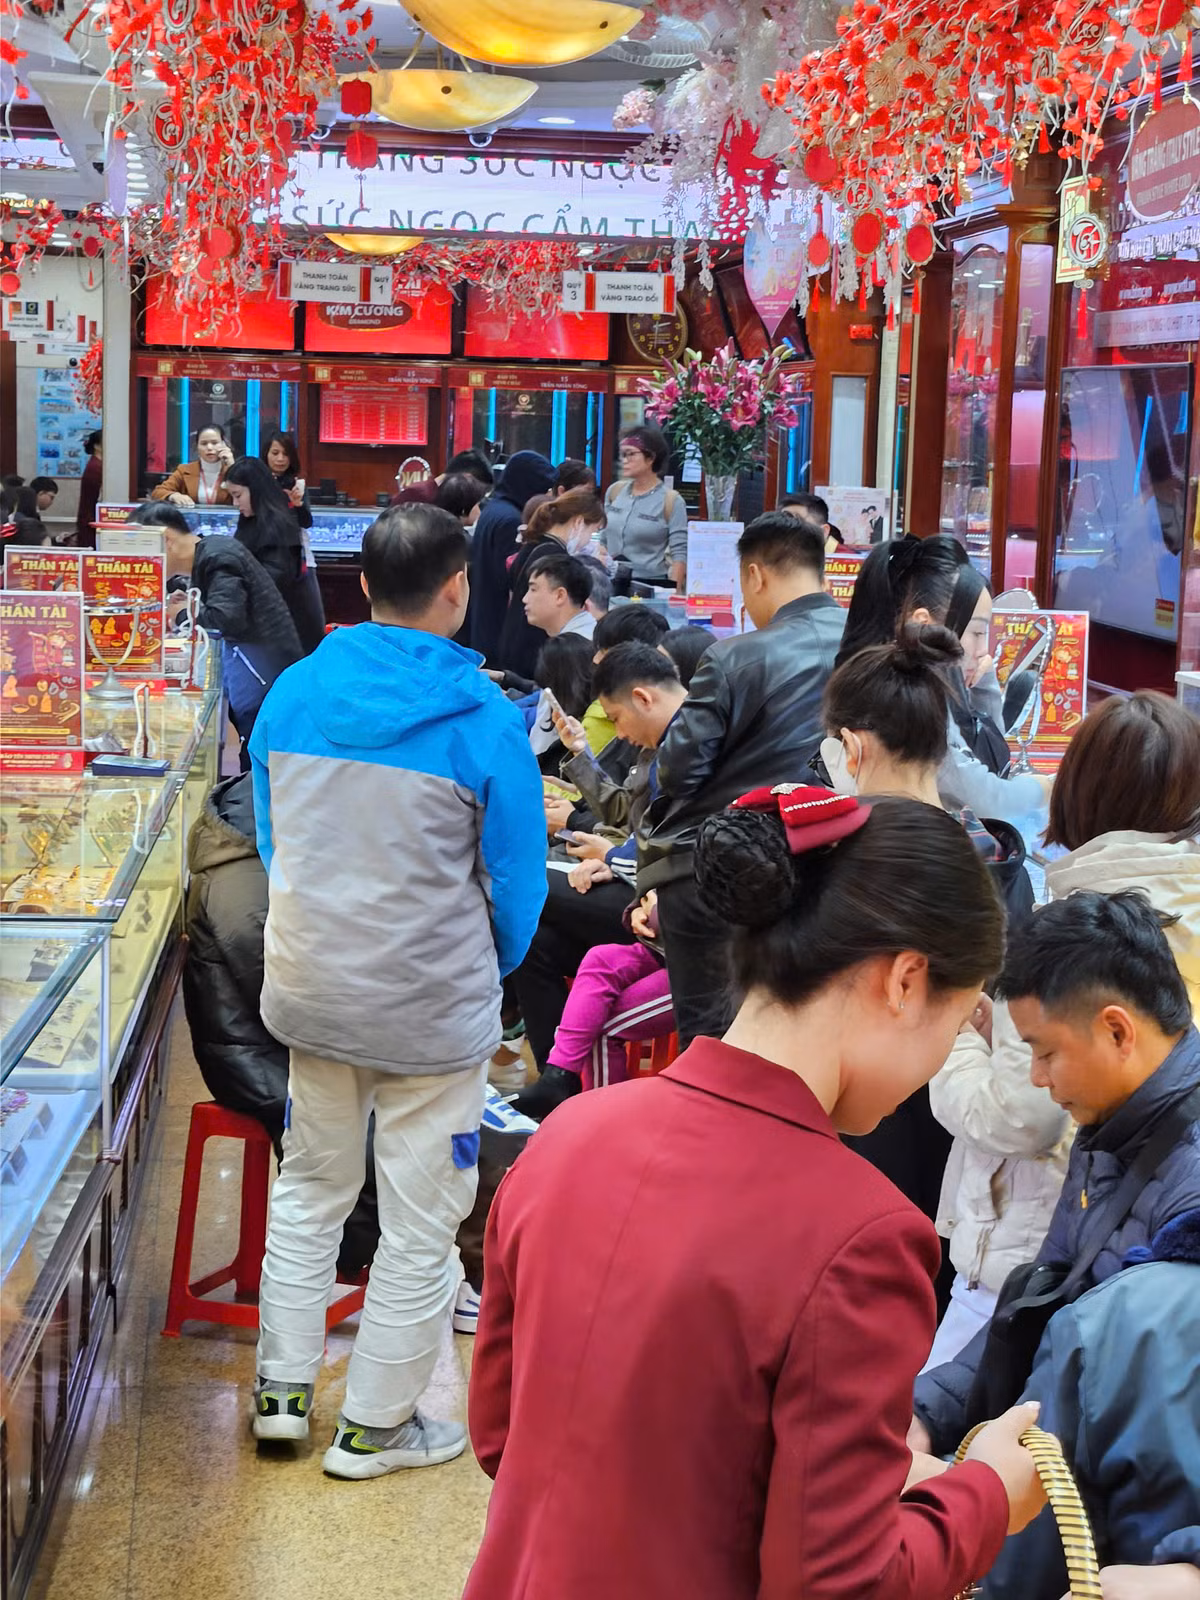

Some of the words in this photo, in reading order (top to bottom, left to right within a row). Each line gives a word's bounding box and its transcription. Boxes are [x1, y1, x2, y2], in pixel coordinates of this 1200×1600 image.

[302, 272, 327, 280] THANH
[328, 273, 348, 281] TOÁN
[294, 281, 315, 290] VÀNG
[317, 283, 340, 291] TRANG
[379, 284, 384, 294] 1
[571, 291, 578, 300] 3
[600, 293, 622, 301] VÀNG
[624, 294, 644, 302] TRAO
[354, 303, 404, 317] CƯƠNG
[848, 563, 861, 573] TÀ
[0, 602, 36, 618] HẦN
[40, 603, 67, 618] TÀI
